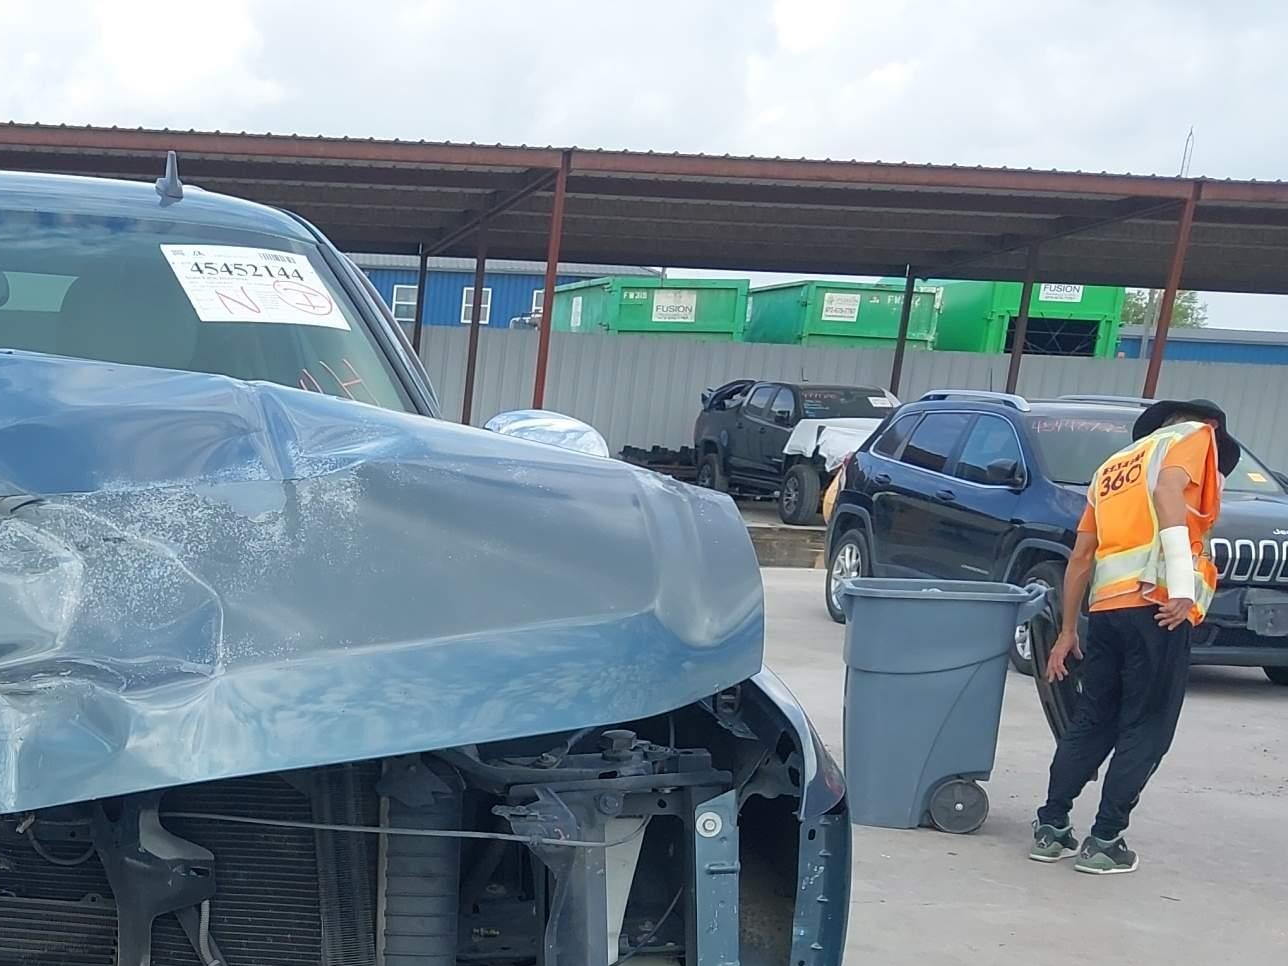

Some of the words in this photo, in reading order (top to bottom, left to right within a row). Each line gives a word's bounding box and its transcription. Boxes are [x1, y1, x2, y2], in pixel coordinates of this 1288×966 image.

[190, 261, 305, 281] 45452144
[1043, 284, 1081, 293] FUSION
[655, 304, 693, 313] FUSION
[1100, 463, 1141, 497] 360
